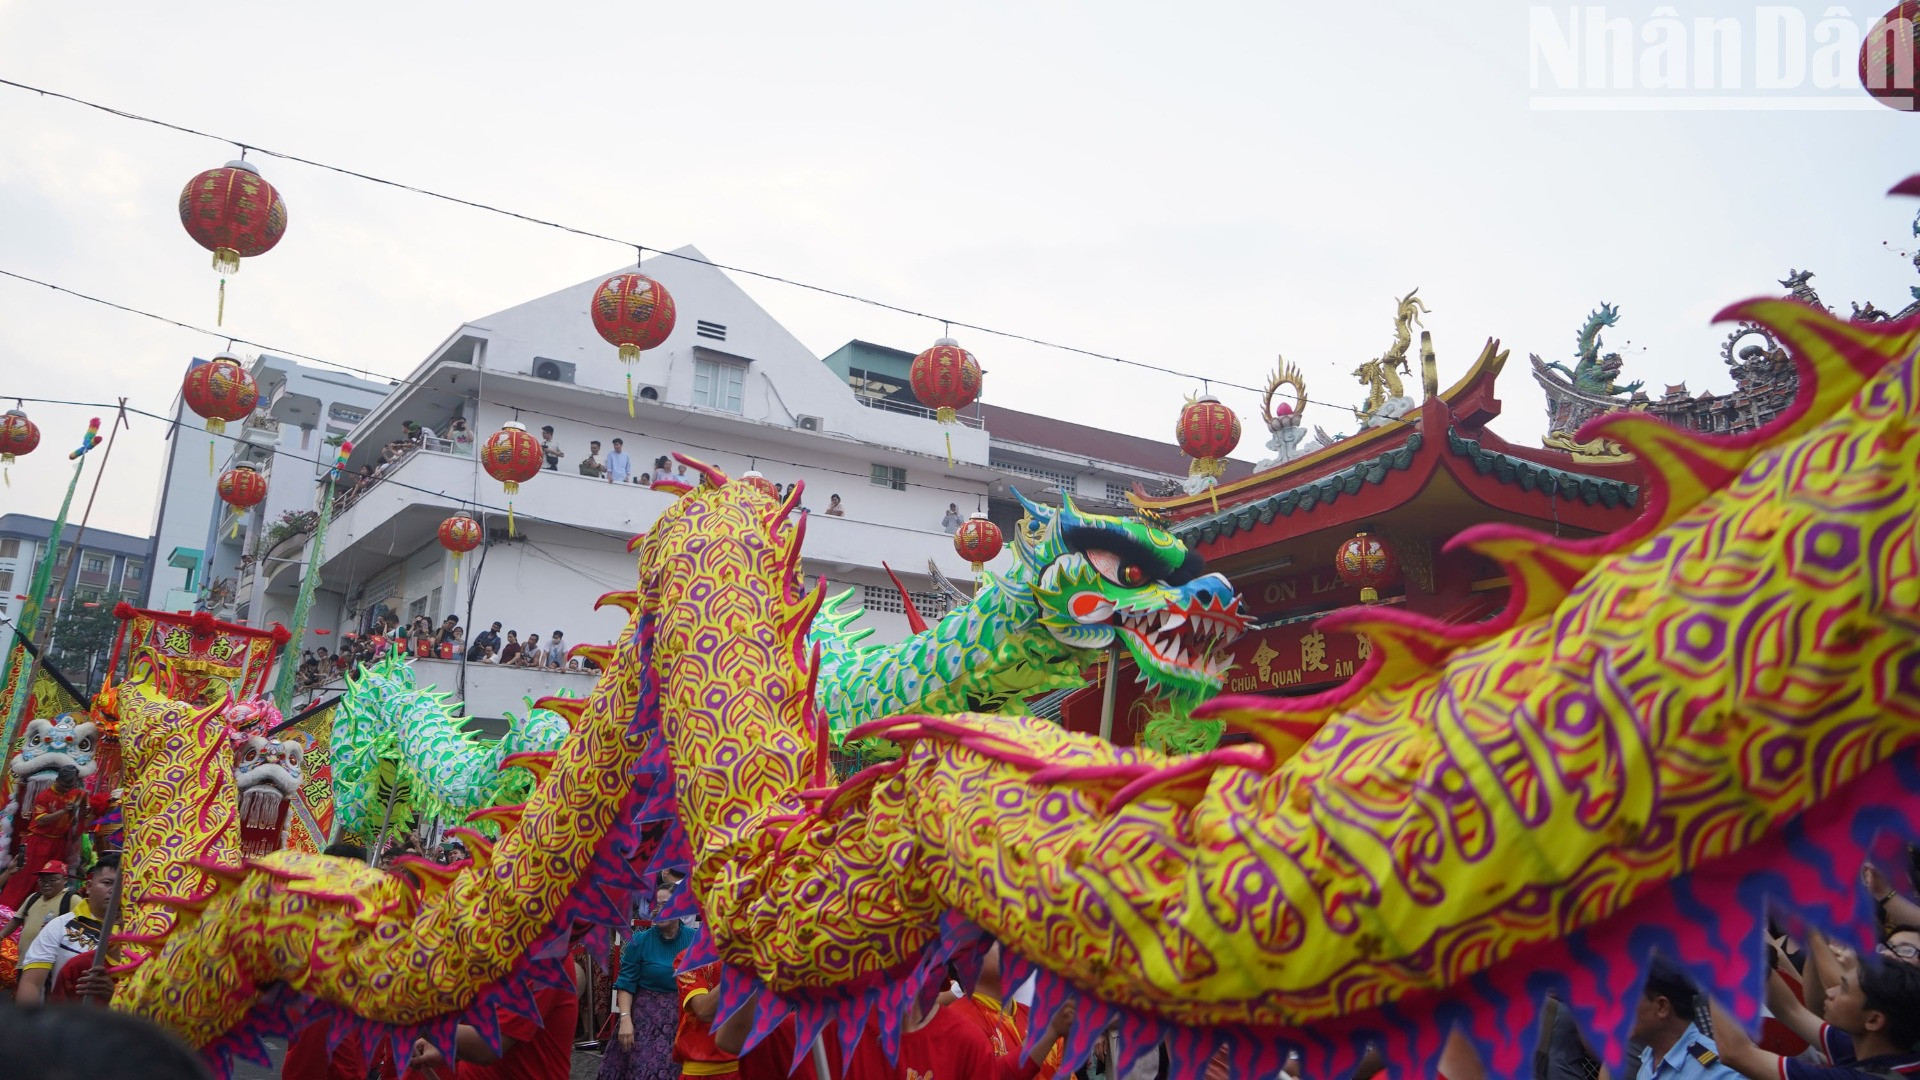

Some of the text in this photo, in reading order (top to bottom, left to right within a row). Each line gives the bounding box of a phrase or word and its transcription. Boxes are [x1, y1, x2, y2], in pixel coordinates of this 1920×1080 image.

[1231, 658, 1354, 693] CHÙA QUAN ÂM
